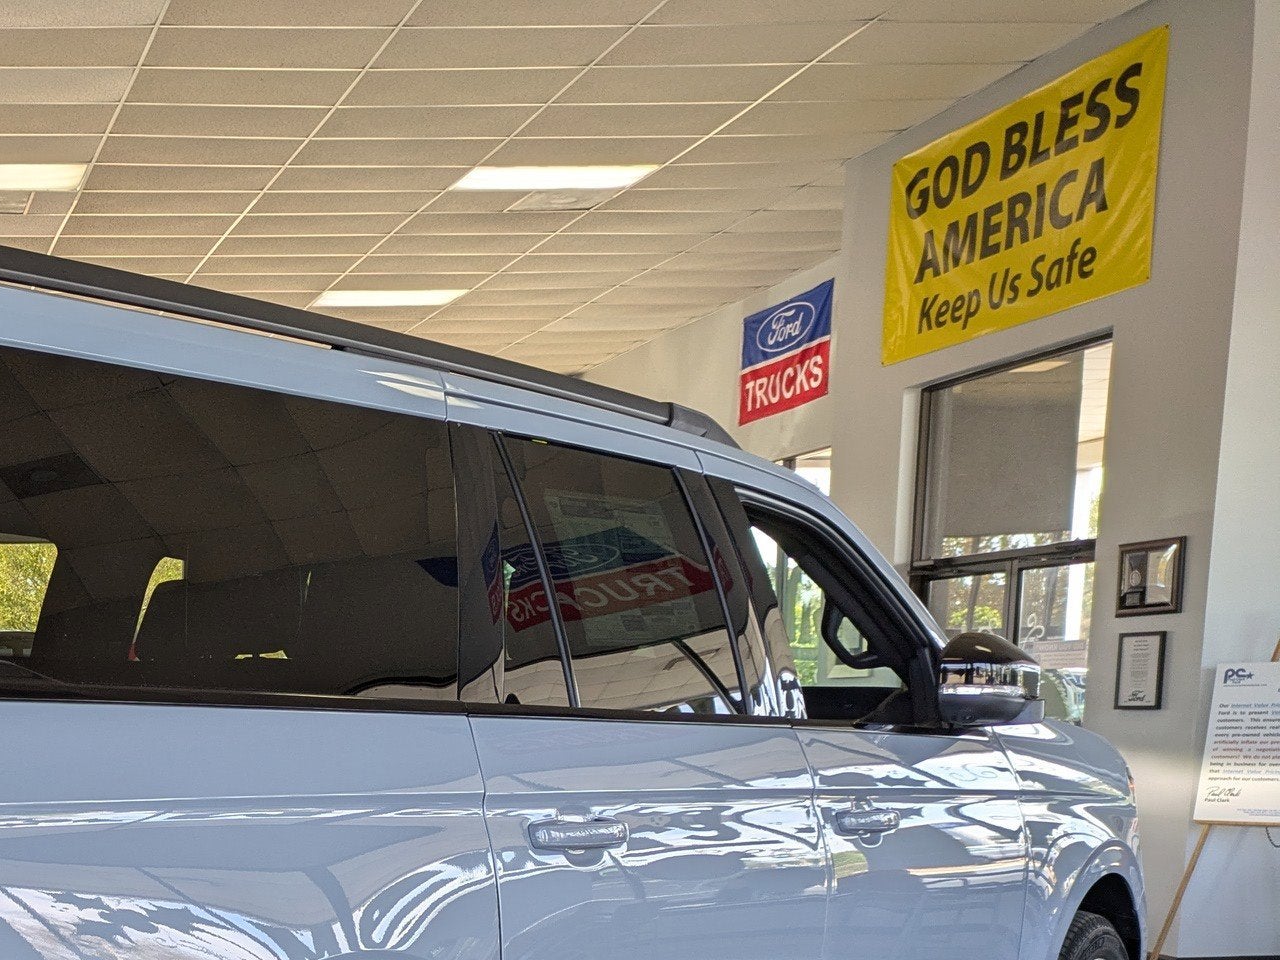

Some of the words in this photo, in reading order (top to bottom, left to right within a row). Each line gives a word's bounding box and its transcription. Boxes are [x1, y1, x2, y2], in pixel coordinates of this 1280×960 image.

[905, 141, 991, 220] GOD
[999, 62, 1143, 182] BLESS
[914, 158, 1108, 284] AMERICA
[767, 309, 804, 345] Ford
[918, 288, 981, 334] Keep
[989, 267, 1021, 309] Us
[1026, 237, 1097, 297] Safe
[745, 355, 823, 412] TRUCKS
